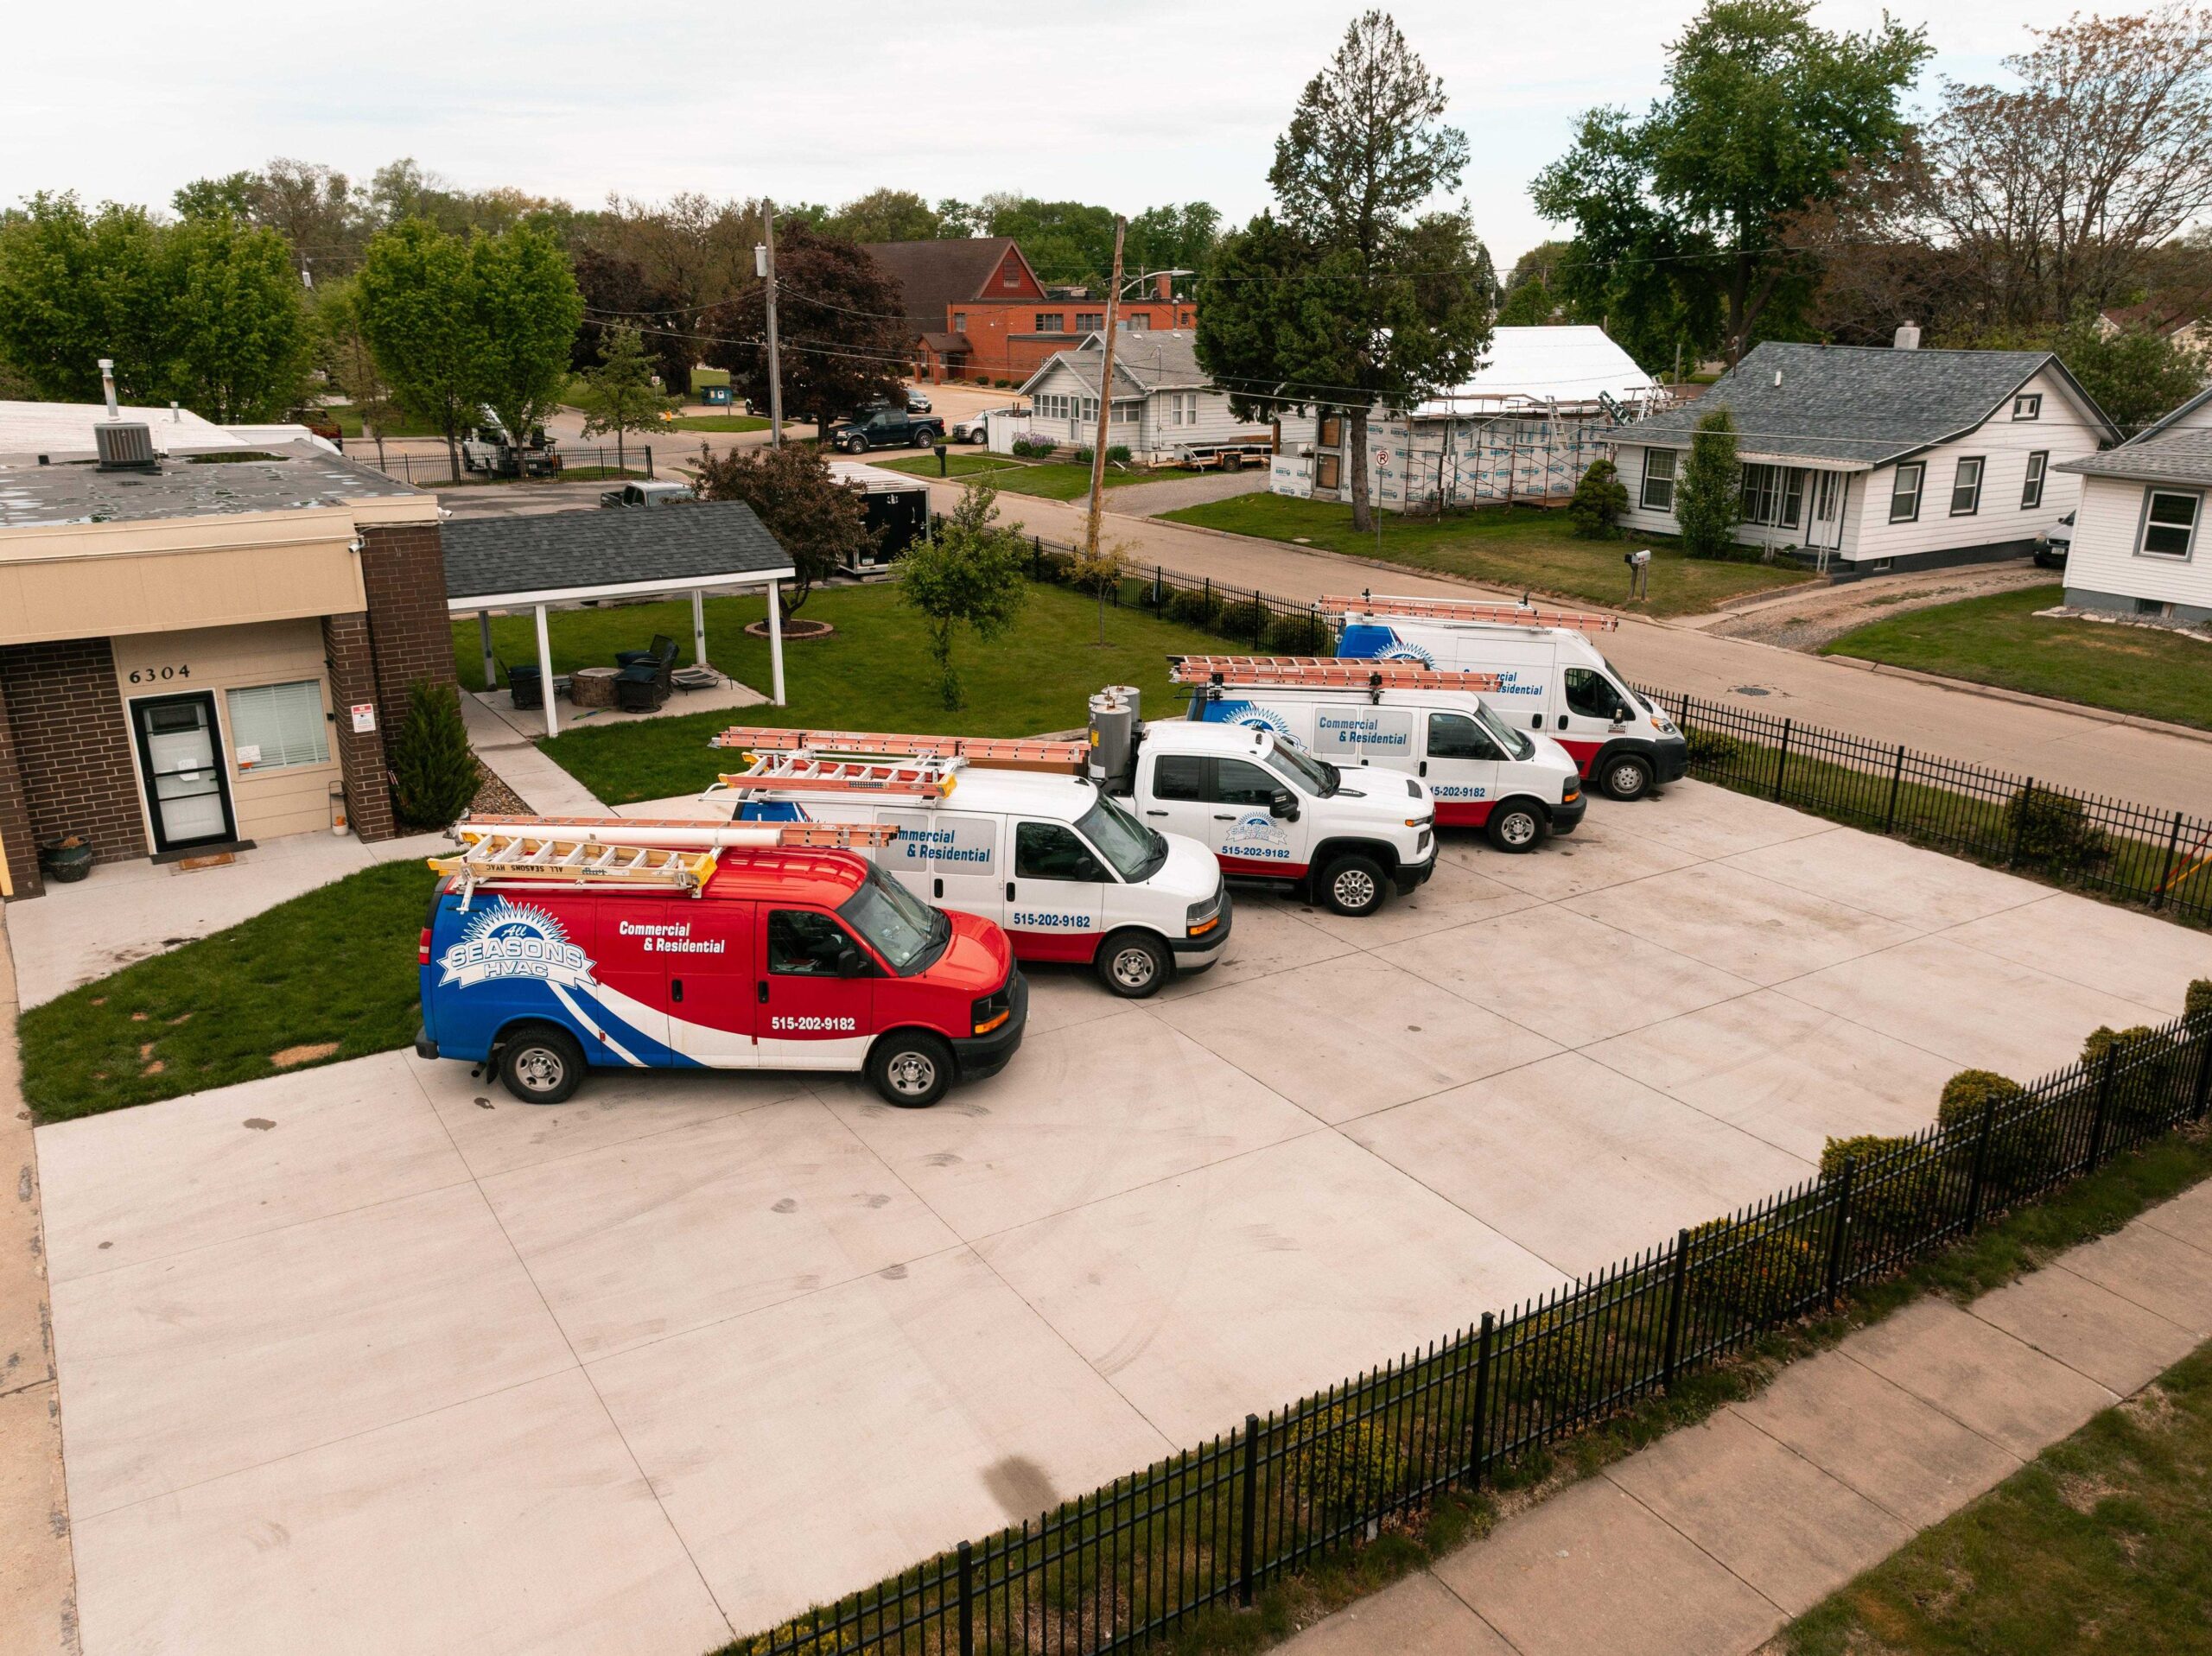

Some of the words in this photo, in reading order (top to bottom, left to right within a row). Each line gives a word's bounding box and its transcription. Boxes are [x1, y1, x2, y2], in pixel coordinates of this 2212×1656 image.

[130, 664, 190, 683] 6304
[1496, 683, 1542, 695] esidential
[1319, 717, 1378, 730] Commercial
[1339, 731, 1346, 741] &
[1349, 732, 1407, 745] Residential
[1430, 786, 1485, 796] 15-202-9182
[899, 829, 955, 843] mmercial
[907, 844, 916, 857] &
[919, 844, 990, 862] Residential
[1222, 846, 1290, 858] 515-202-9182
[1014, 912, 1090, 928] 515-202-9182
[501, 924, 527, 936] All
[620, 921, 690, 936] Commercial
[644, 937, 653, 951] &
[657, 938, 725, 953] Residential
[450, 937, 583, 968] SEASONS
[484, 960, 549, 978] HVAC
[772, 1017, 855, 1030] 515-202-9182
